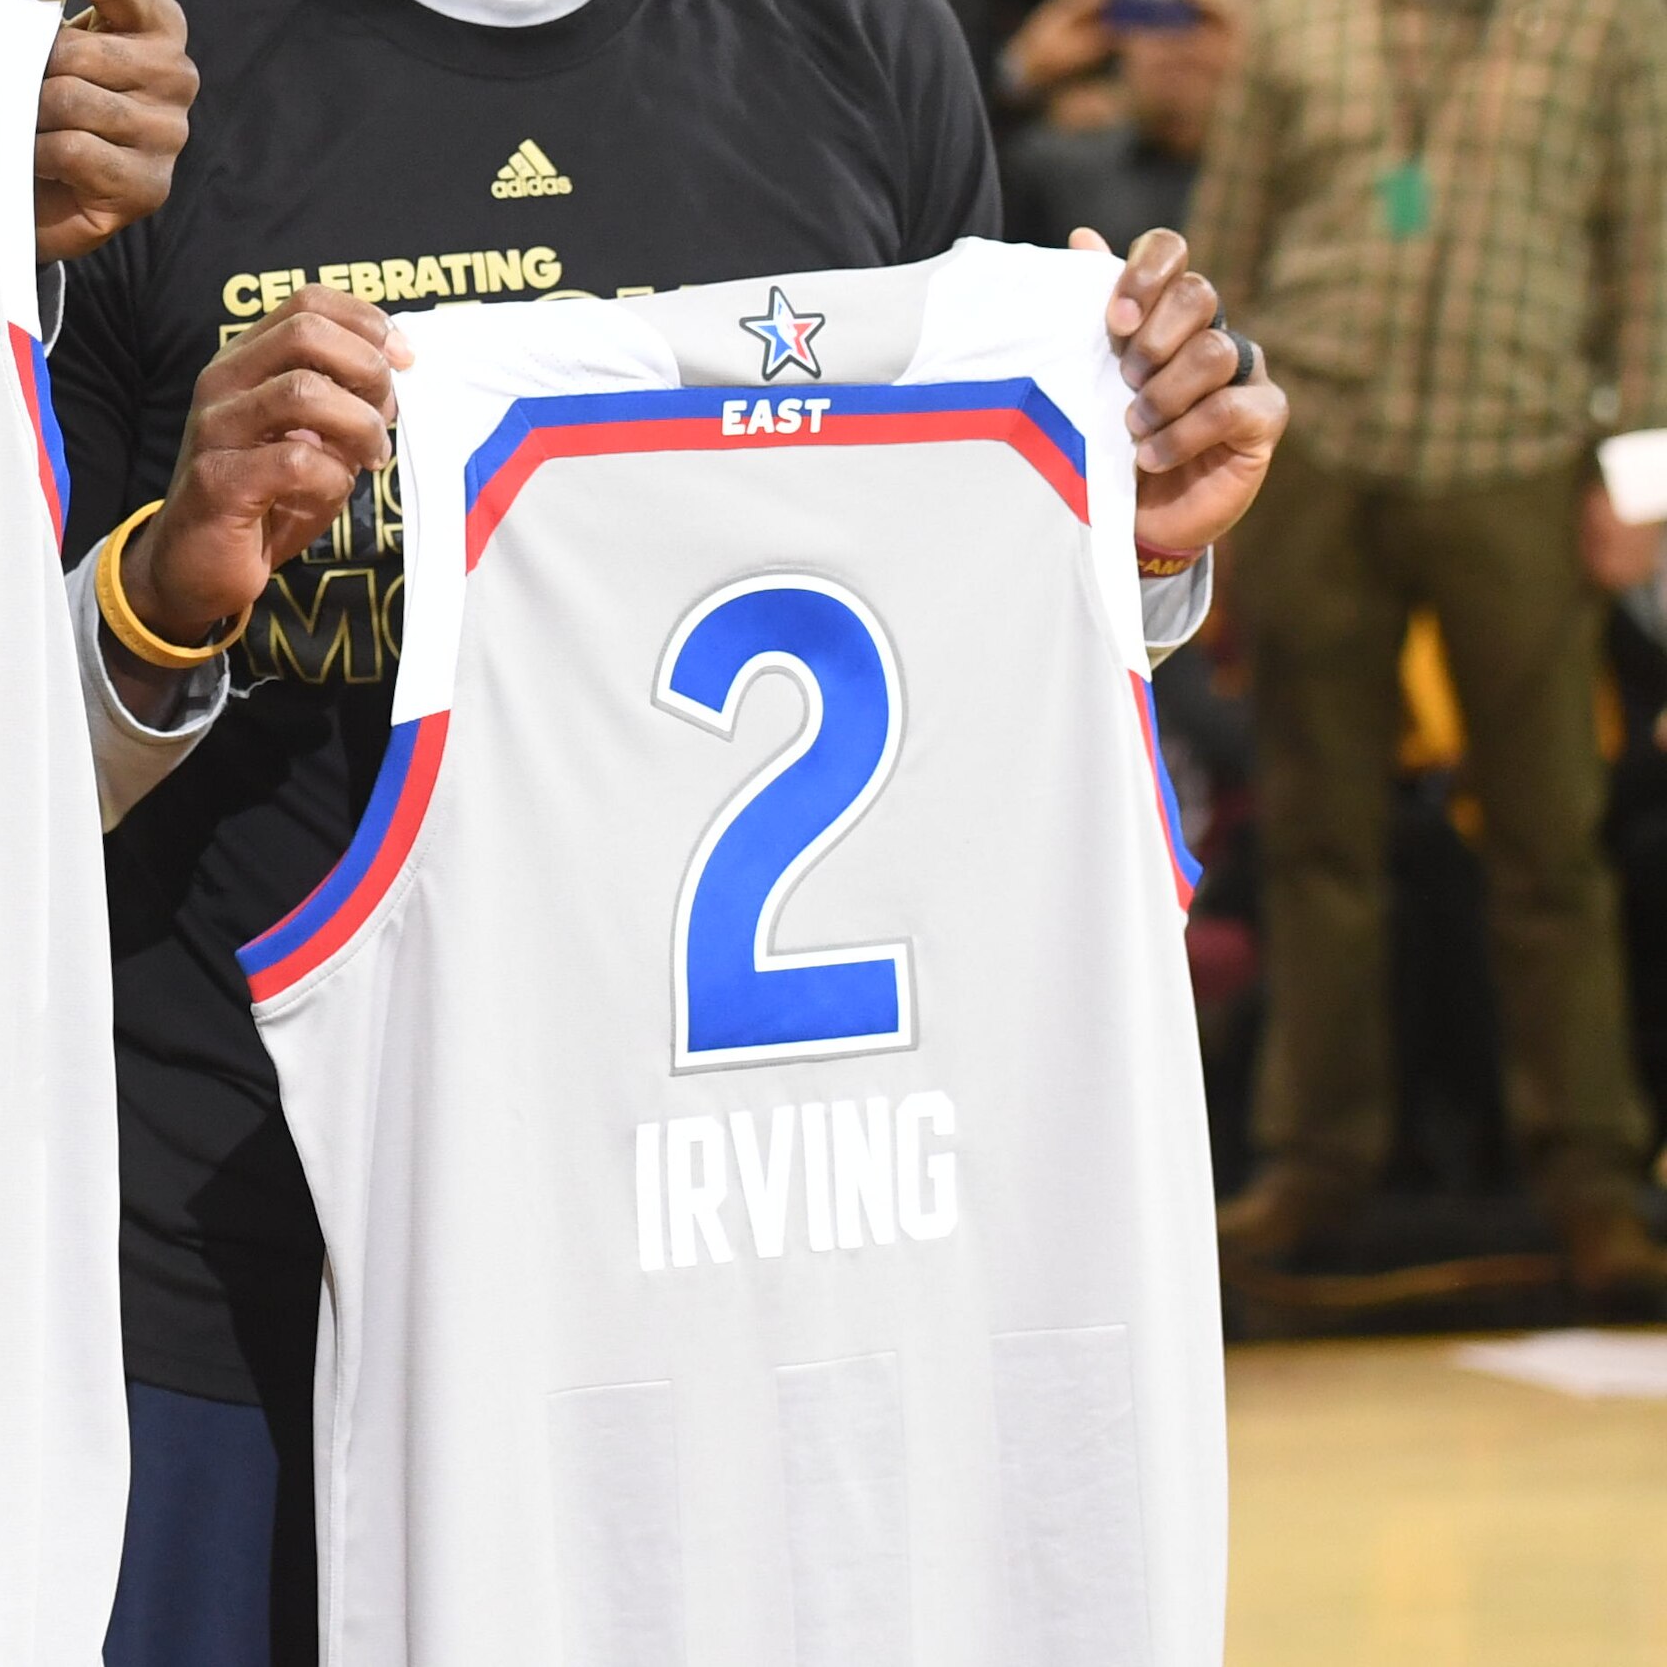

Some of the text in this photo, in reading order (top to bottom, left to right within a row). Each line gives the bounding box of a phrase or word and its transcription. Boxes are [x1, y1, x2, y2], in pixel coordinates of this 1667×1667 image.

[490, 174, 573, 199] adidas
[721, 397, 832, 437] EAST
[650, 564, 918, 1077] 2
[635, 1089, 959, 1273] IRVING
